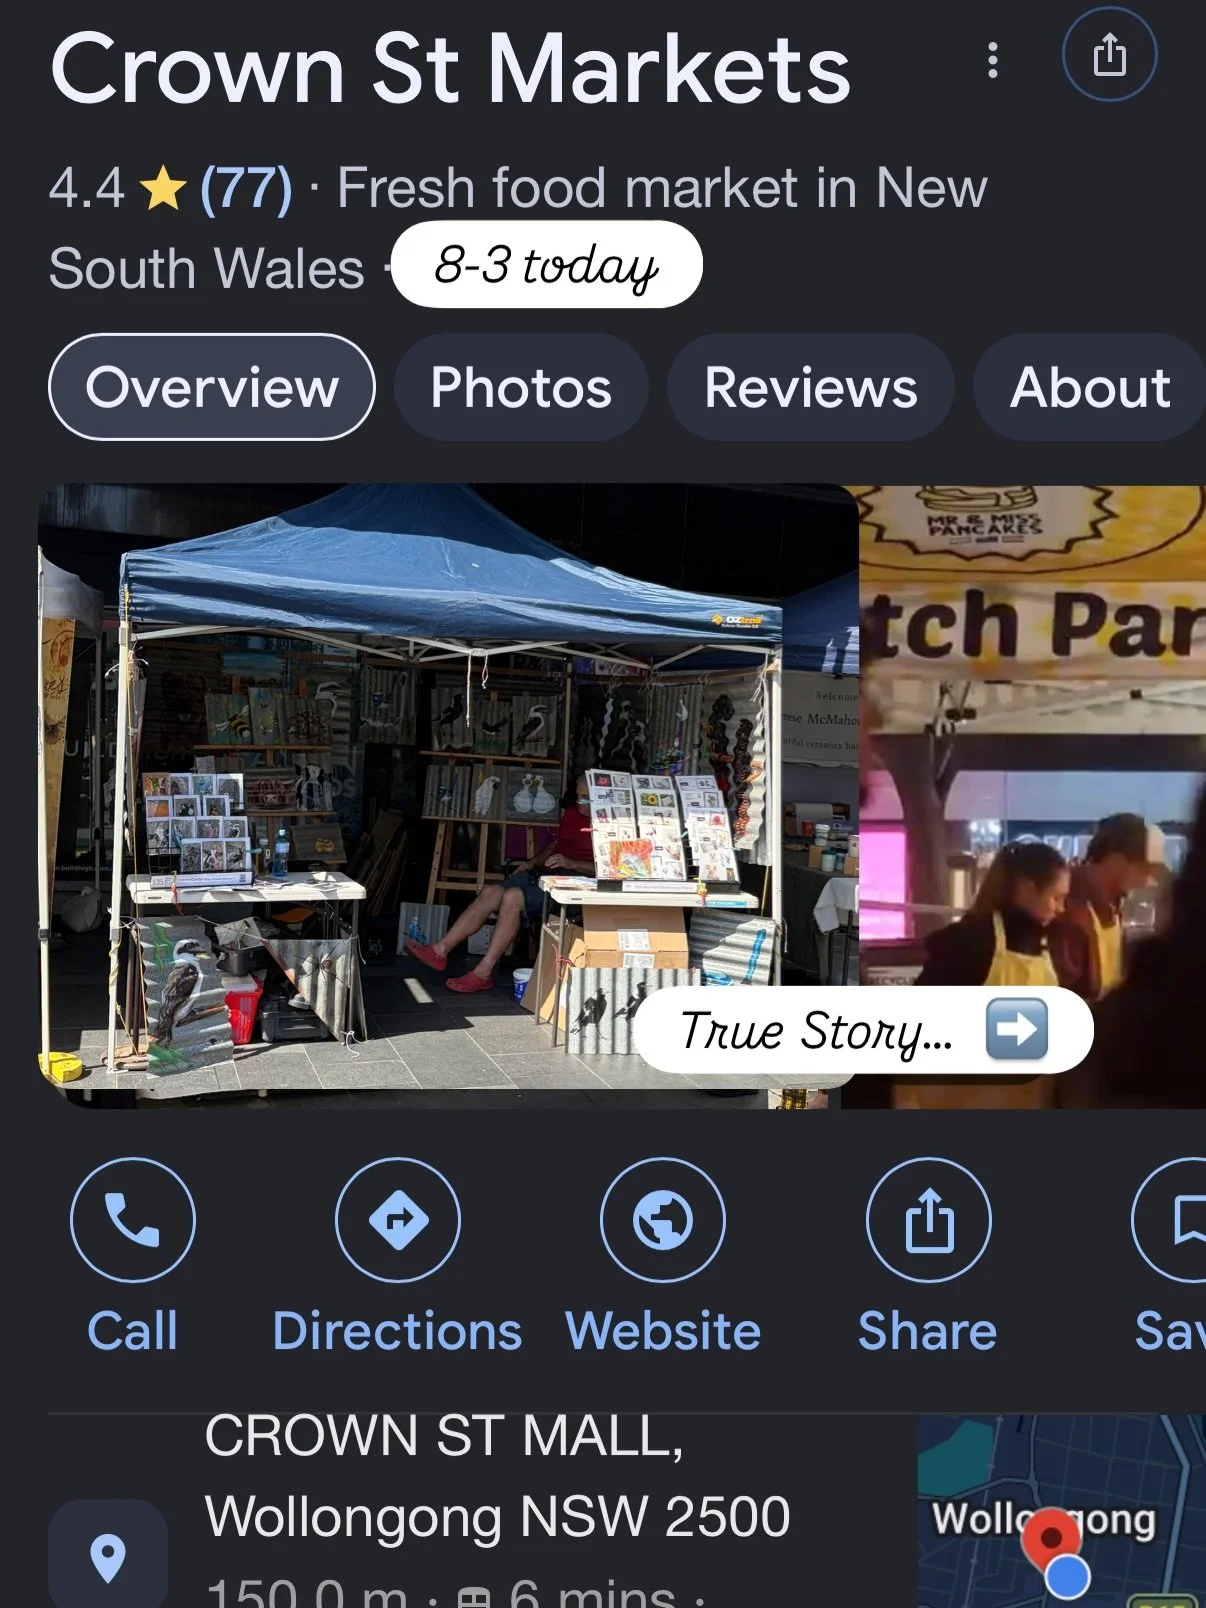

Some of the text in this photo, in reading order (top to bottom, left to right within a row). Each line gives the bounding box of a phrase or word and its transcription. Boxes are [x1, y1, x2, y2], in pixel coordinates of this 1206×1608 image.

[51, 30, 851, 105] Crown St Markets
[48, 164, 989, 219] 4.4 (77) Fresh food market in New
[49, 245, 365, 290] South Wales
[85, 364, 340, 409] Overview
[432, 365, 612, 409] Photos
[706, 364, 918, 409] Reviews
[1009, 365, 1171, 409] About
[927, 512, 1042, 526] MR & MISS
[928, 523, 1044, 537] PANCAKES
[87, 1309, 177, 1351] Call
[274, 1308, 523, 1351] Directions
[564, 1308, 761, 1351] Website
[858, 1309, 997, 1351] Share
[205, 1414, 682, 1464] CROWN ST MALL,
[204, 1493, 790, 1549] Wollongong NSW 2500
[363, 1589, 407, 1608] m
[510, 1579, 540, 1608] 6
[559, 1578, 676, 1608] mins
